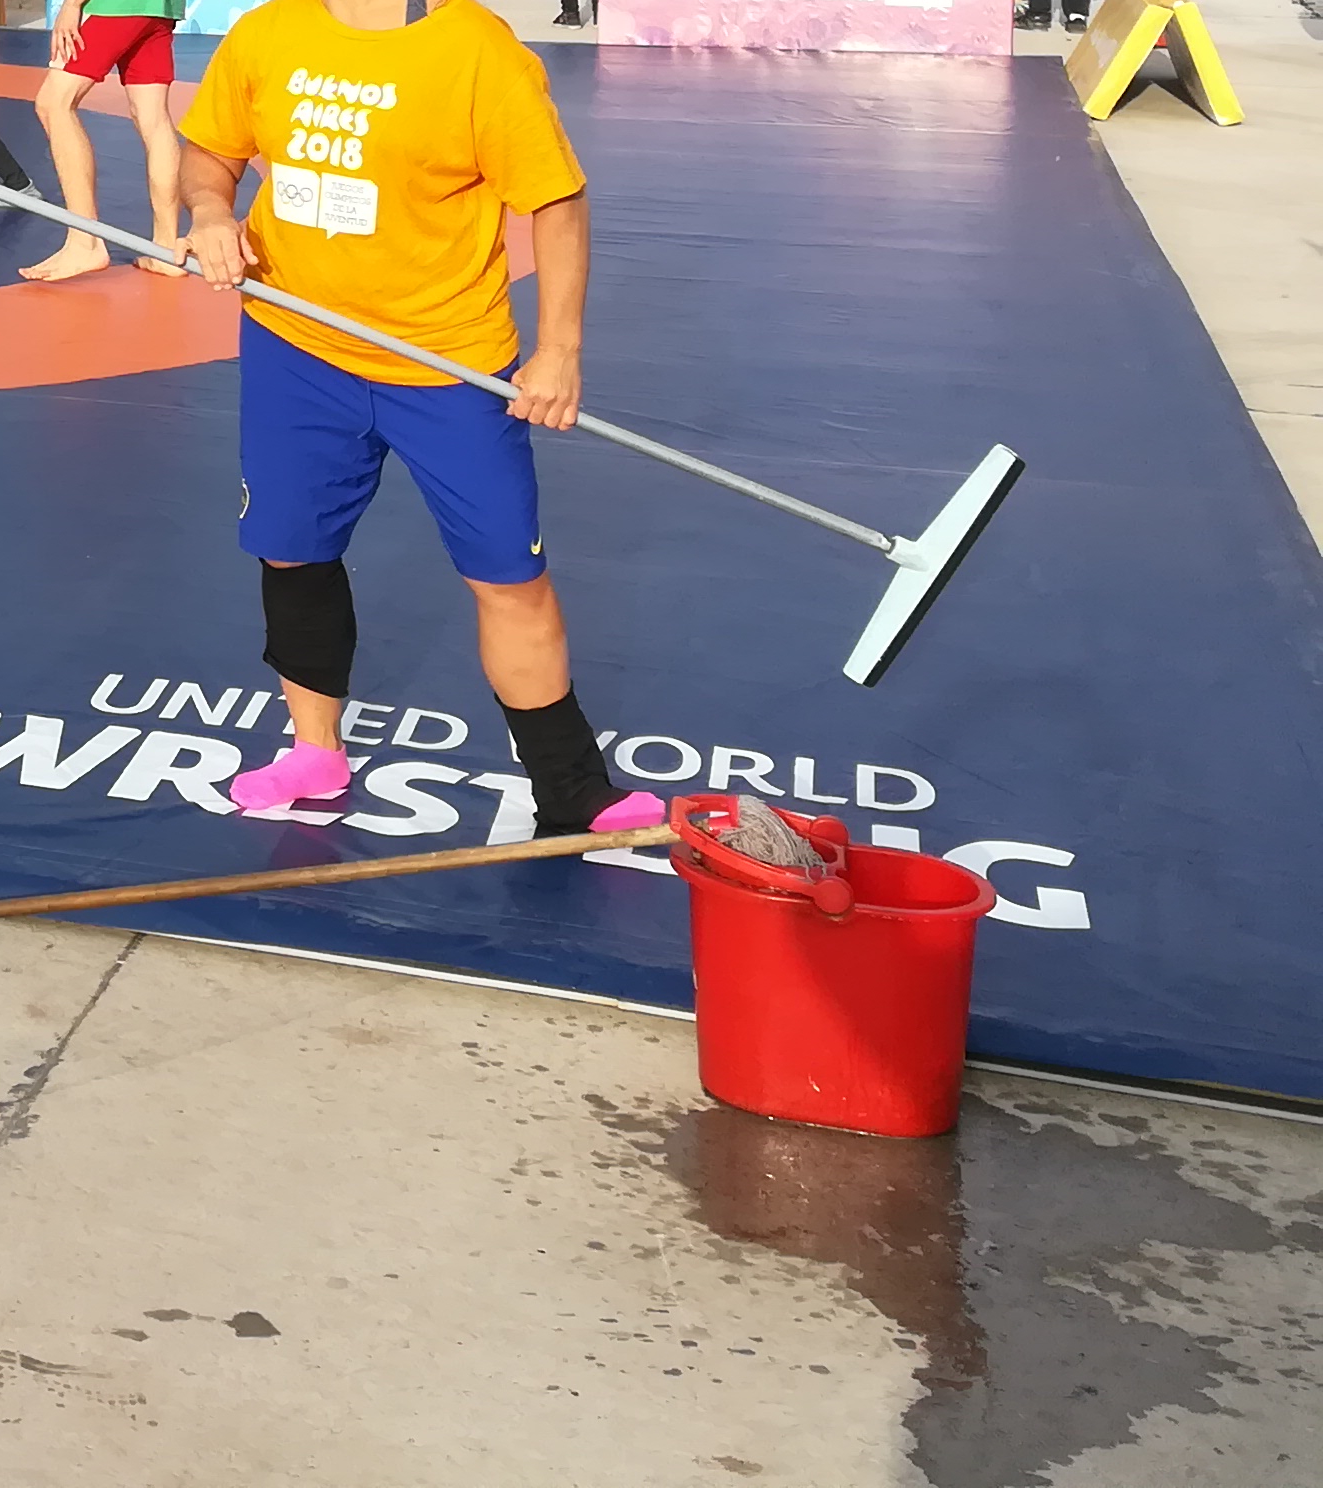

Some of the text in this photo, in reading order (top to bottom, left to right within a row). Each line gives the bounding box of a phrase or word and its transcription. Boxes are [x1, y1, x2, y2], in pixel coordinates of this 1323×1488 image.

[285, 66, 397, 110] BUENOS
[290, 98, 373, 137] AIRES
[286, 127, 363, 171] 2018
